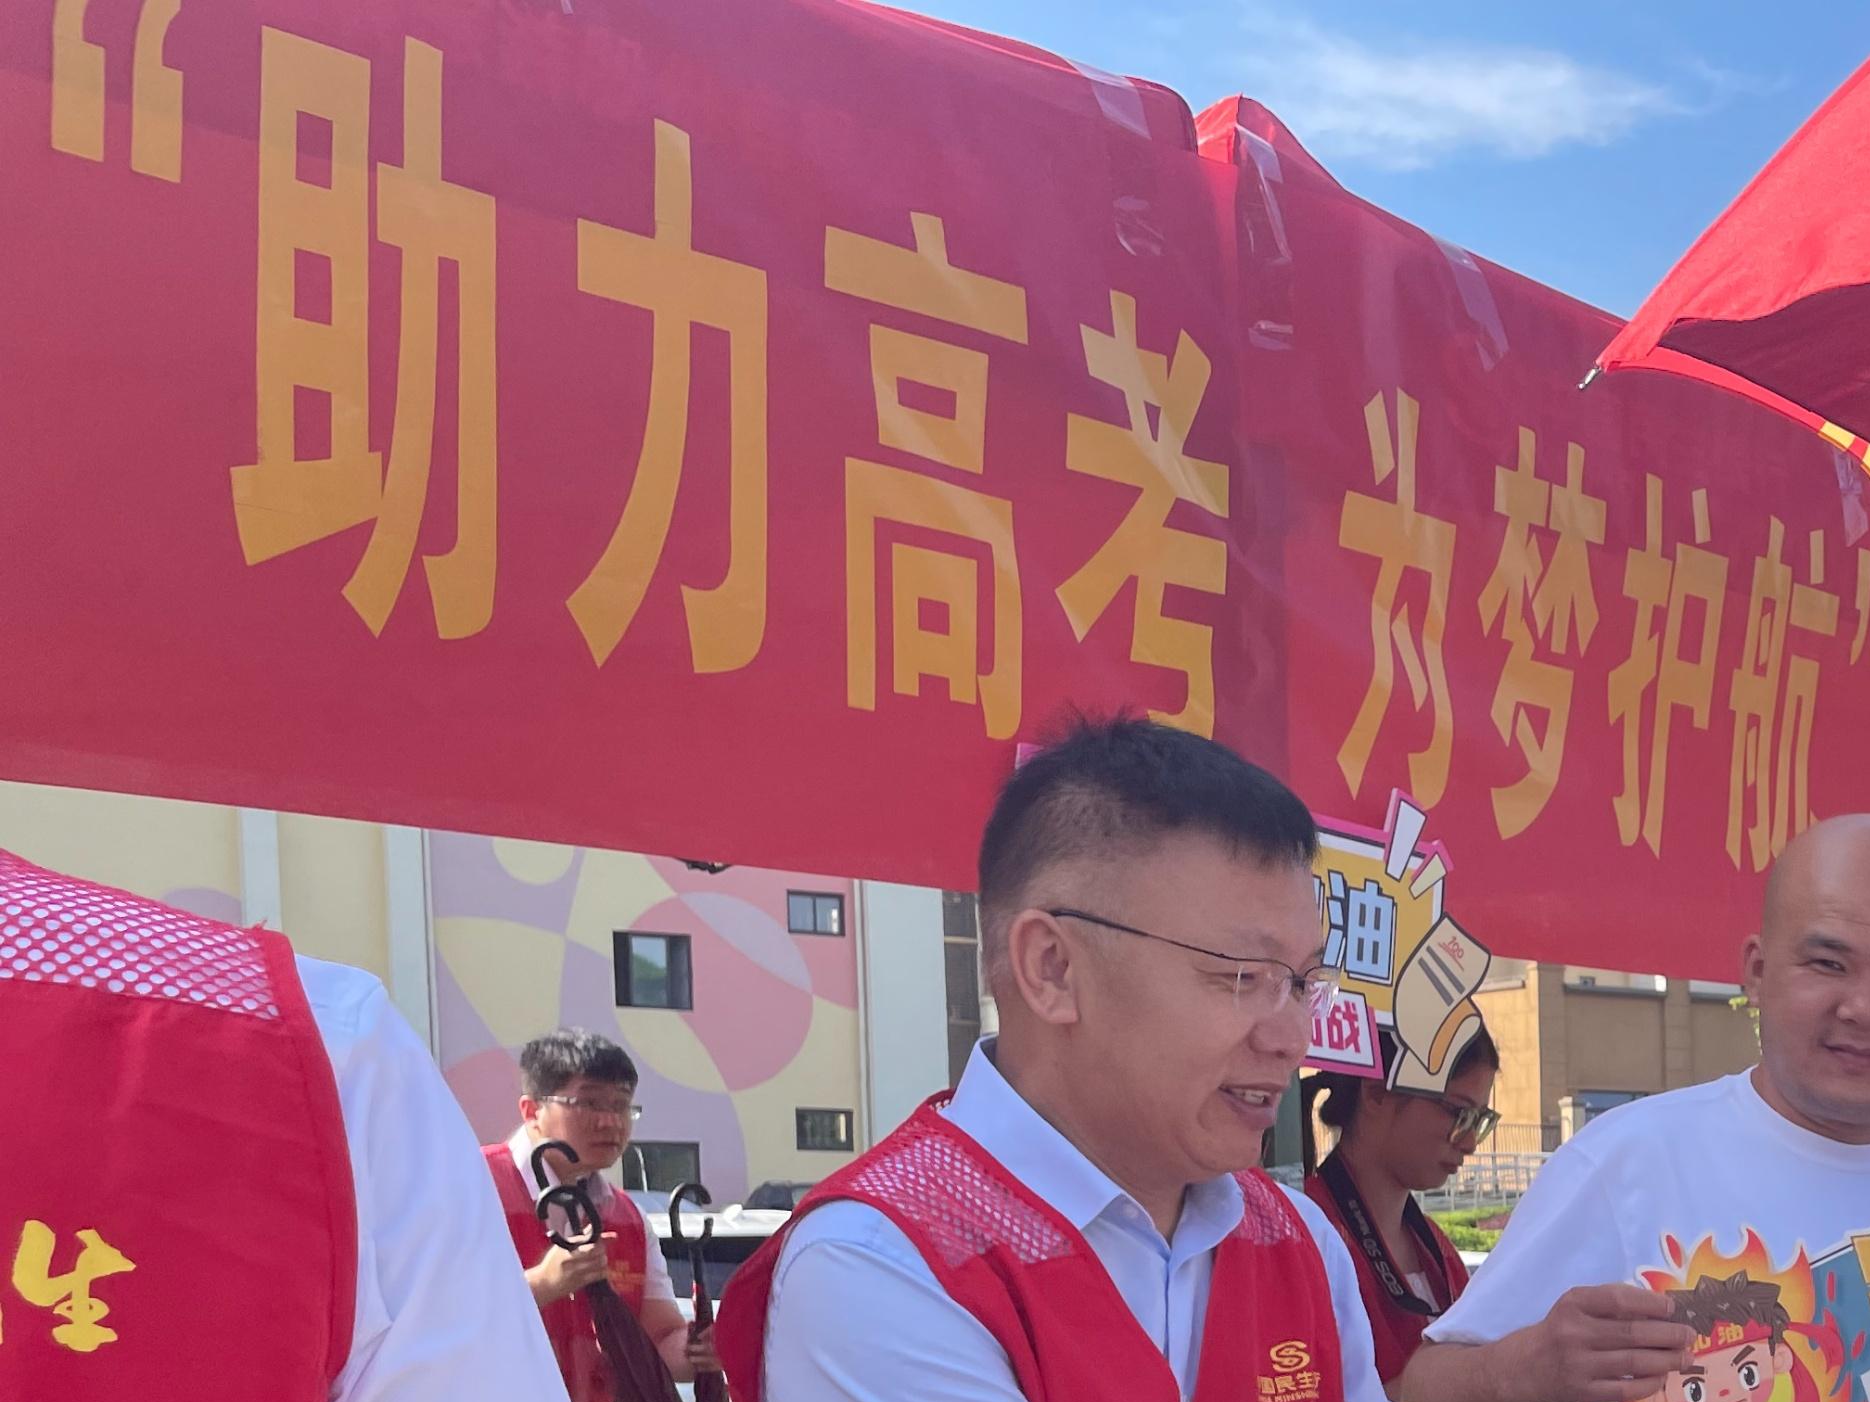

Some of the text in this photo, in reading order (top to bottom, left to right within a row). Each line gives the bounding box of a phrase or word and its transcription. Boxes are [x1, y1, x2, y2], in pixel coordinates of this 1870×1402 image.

[51, 0, 1230, 740] “助力高考
[1312, 869, 1397, 986] 油
[1312, 1000, 1361, 1053] 战
[12, 1219, 137, 1353] 生
